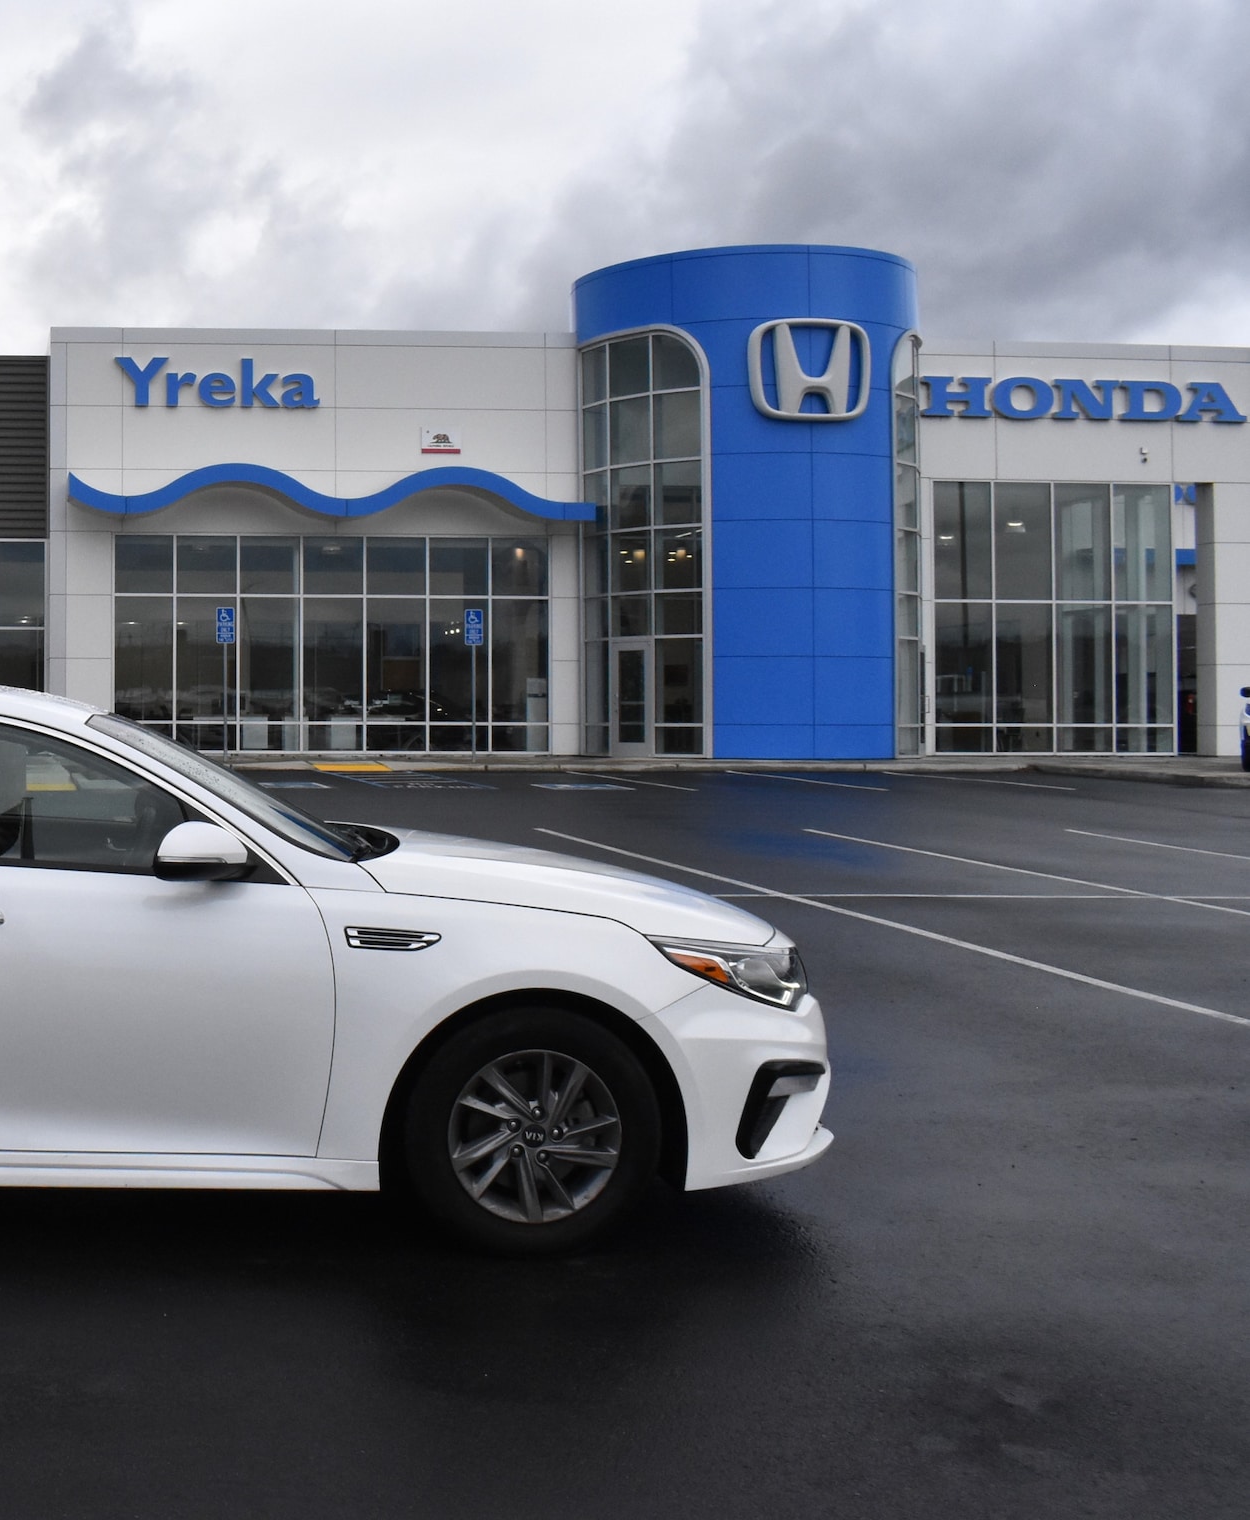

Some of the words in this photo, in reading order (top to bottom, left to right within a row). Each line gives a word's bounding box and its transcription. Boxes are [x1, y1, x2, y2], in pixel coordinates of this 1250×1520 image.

[114, 356, 321, 409] Yreka
[920, 375, 1248, 423] HONDA
[525, 1130, 544, 1142] KIA
